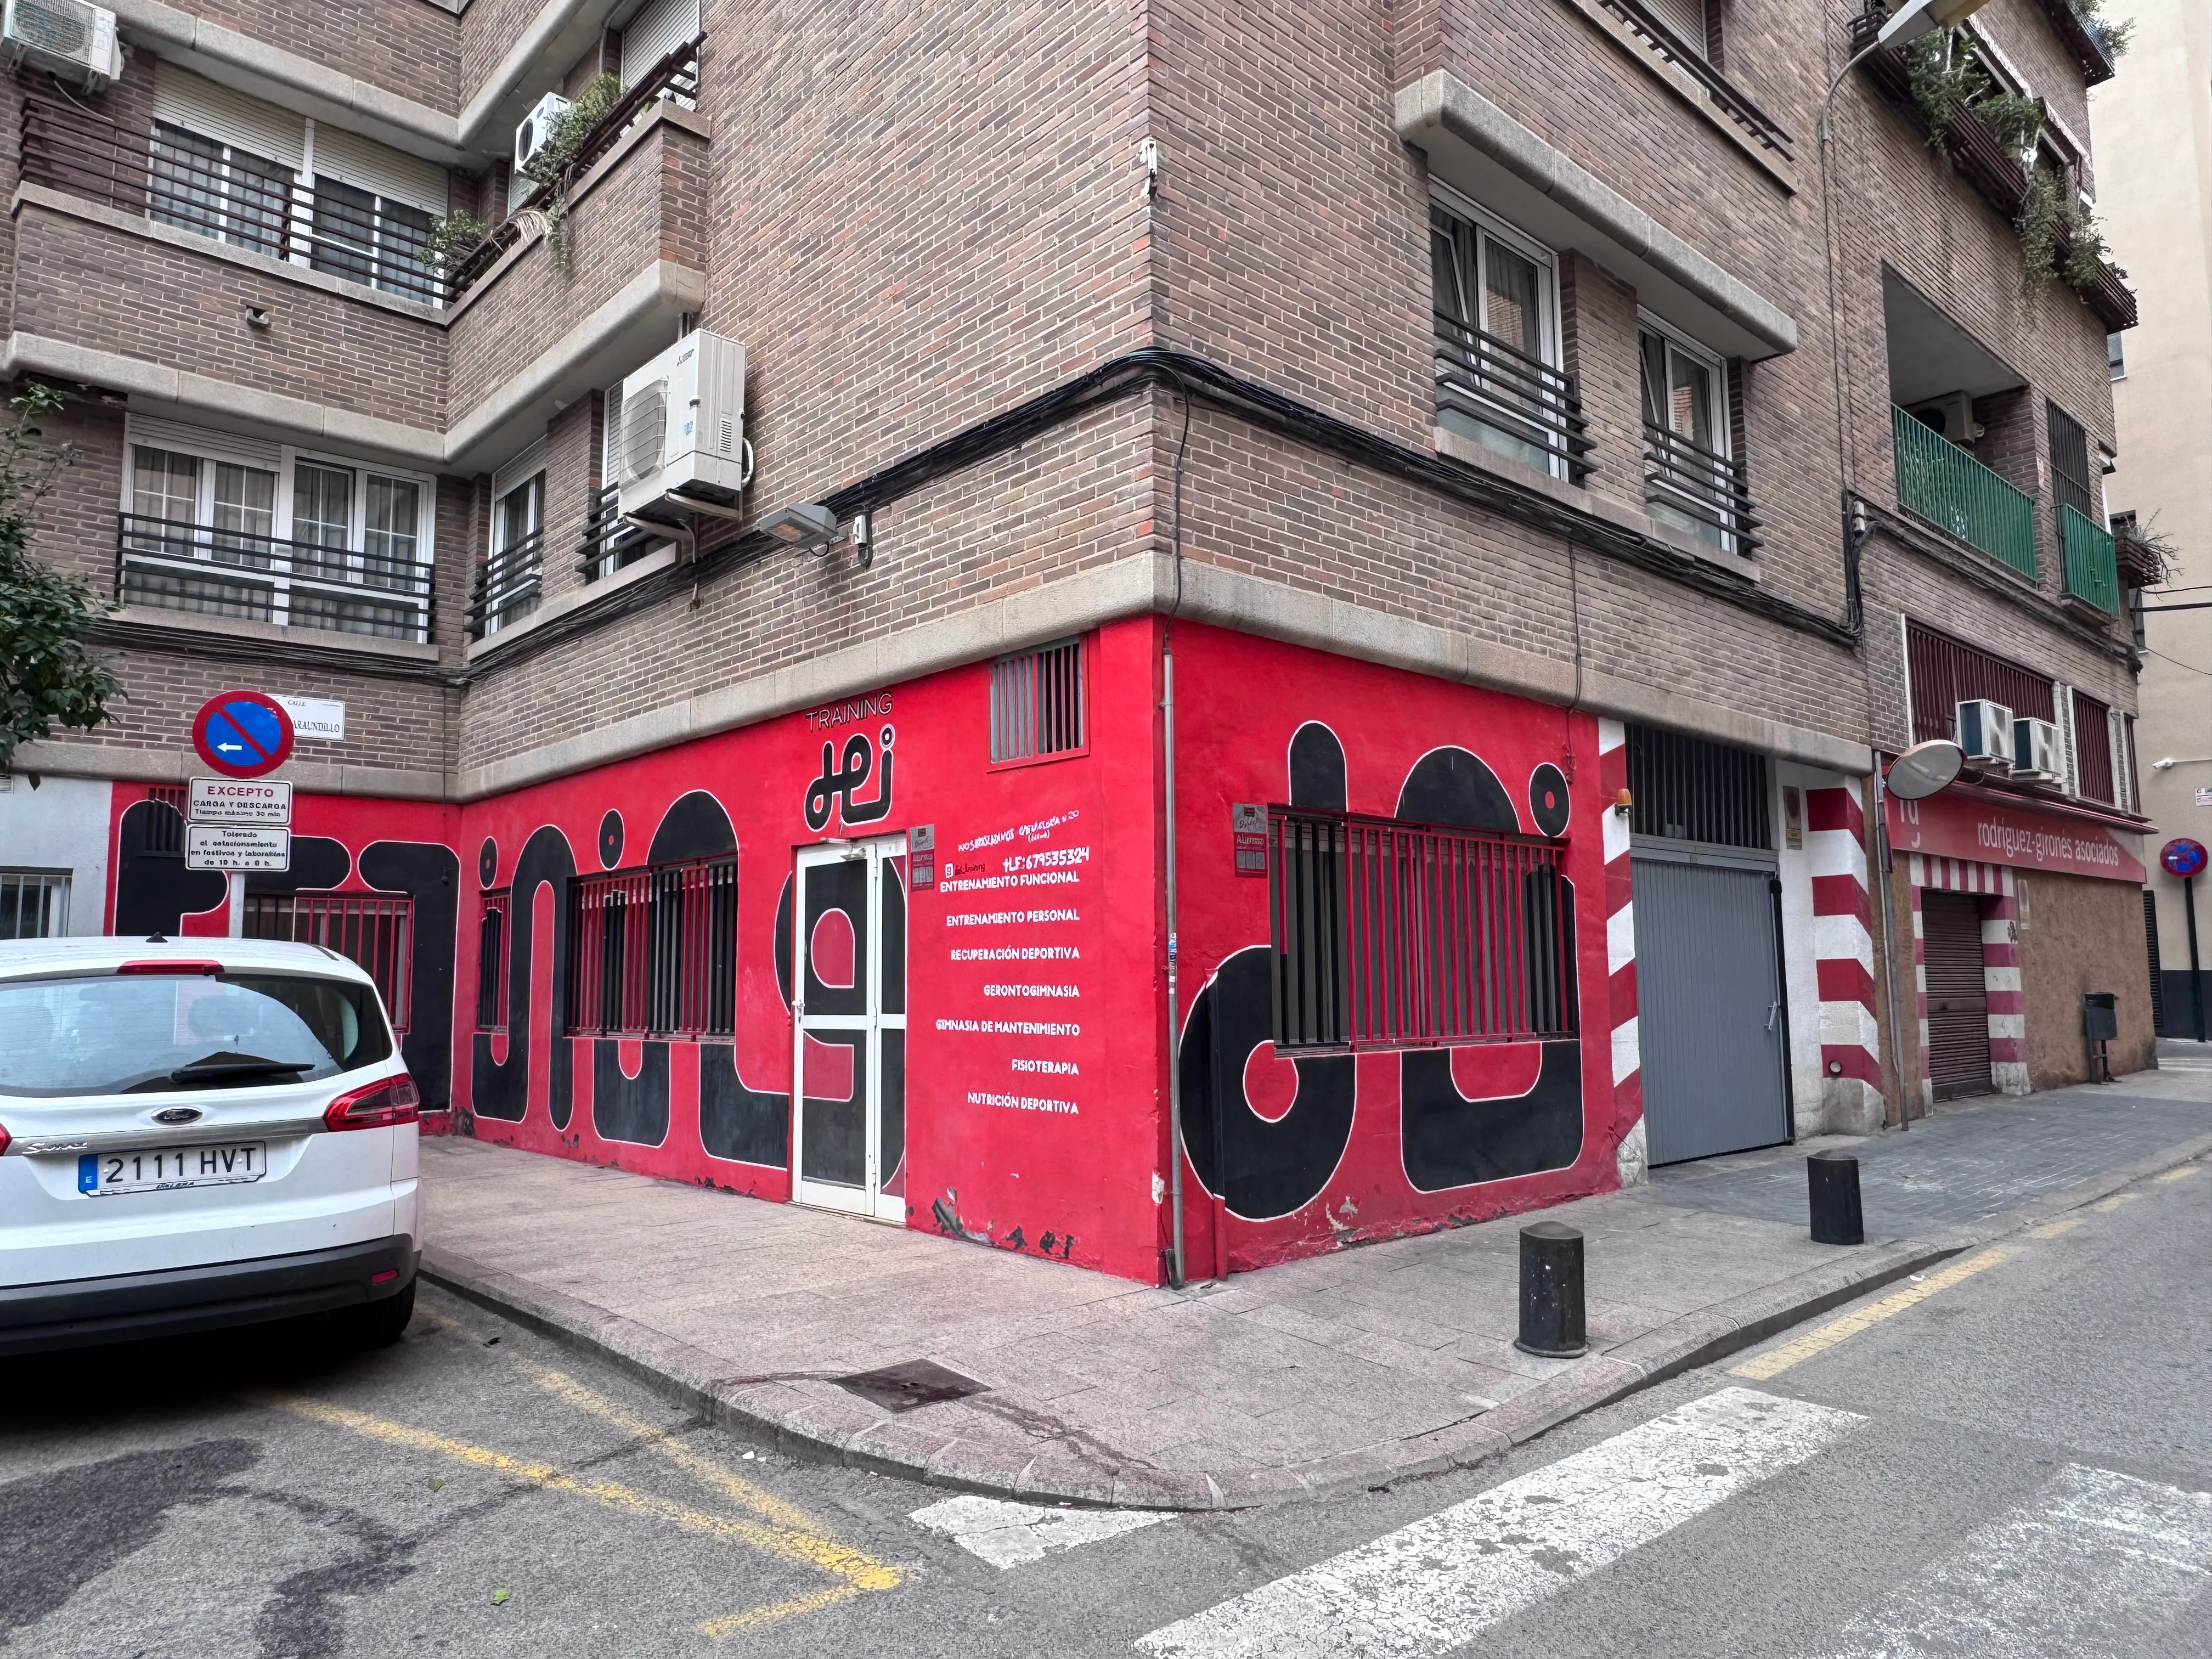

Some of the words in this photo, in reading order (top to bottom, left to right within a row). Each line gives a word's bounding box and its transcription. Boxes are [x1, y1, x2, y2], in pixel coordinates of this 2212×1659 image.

[804, 692, 895, 733] TRAINING
[207, 786, 274, 798] EXCEPTO
[2075, 836, 2119, 866] asociados
[940, 875, 1018, 893] ENTRENAMIENTO
[1020, 871, 1080, 887] FUNCIONAL
[946, 911, 1025, 927] ENTRENAMIENTO
[1026, 909, 1080, 923] PERSONAL
[951, 945, 1020, 961] RECUPERACIÓN
[1022, 947, 1080, 960] DEPORTIVA
[984, 985, 1080, 997] GERONTOGIMNASIA
[936, 1019, 979, 1032] GIMNASIA
[981, 1021, 994, 1033] DE
[995, 1022, 1080, 1036] MANTENIMIENTO
[1012, 1058, 1080, 1075] FISIOTERAPIA
[967, 1092, 1019, 1109] NUTRICIÓN
[1020, 1097, 1079, 1114] DEPORTIVA
[106, 1153, 184, 1183] 2111
[200, 1148, 256, 1175] HVT
